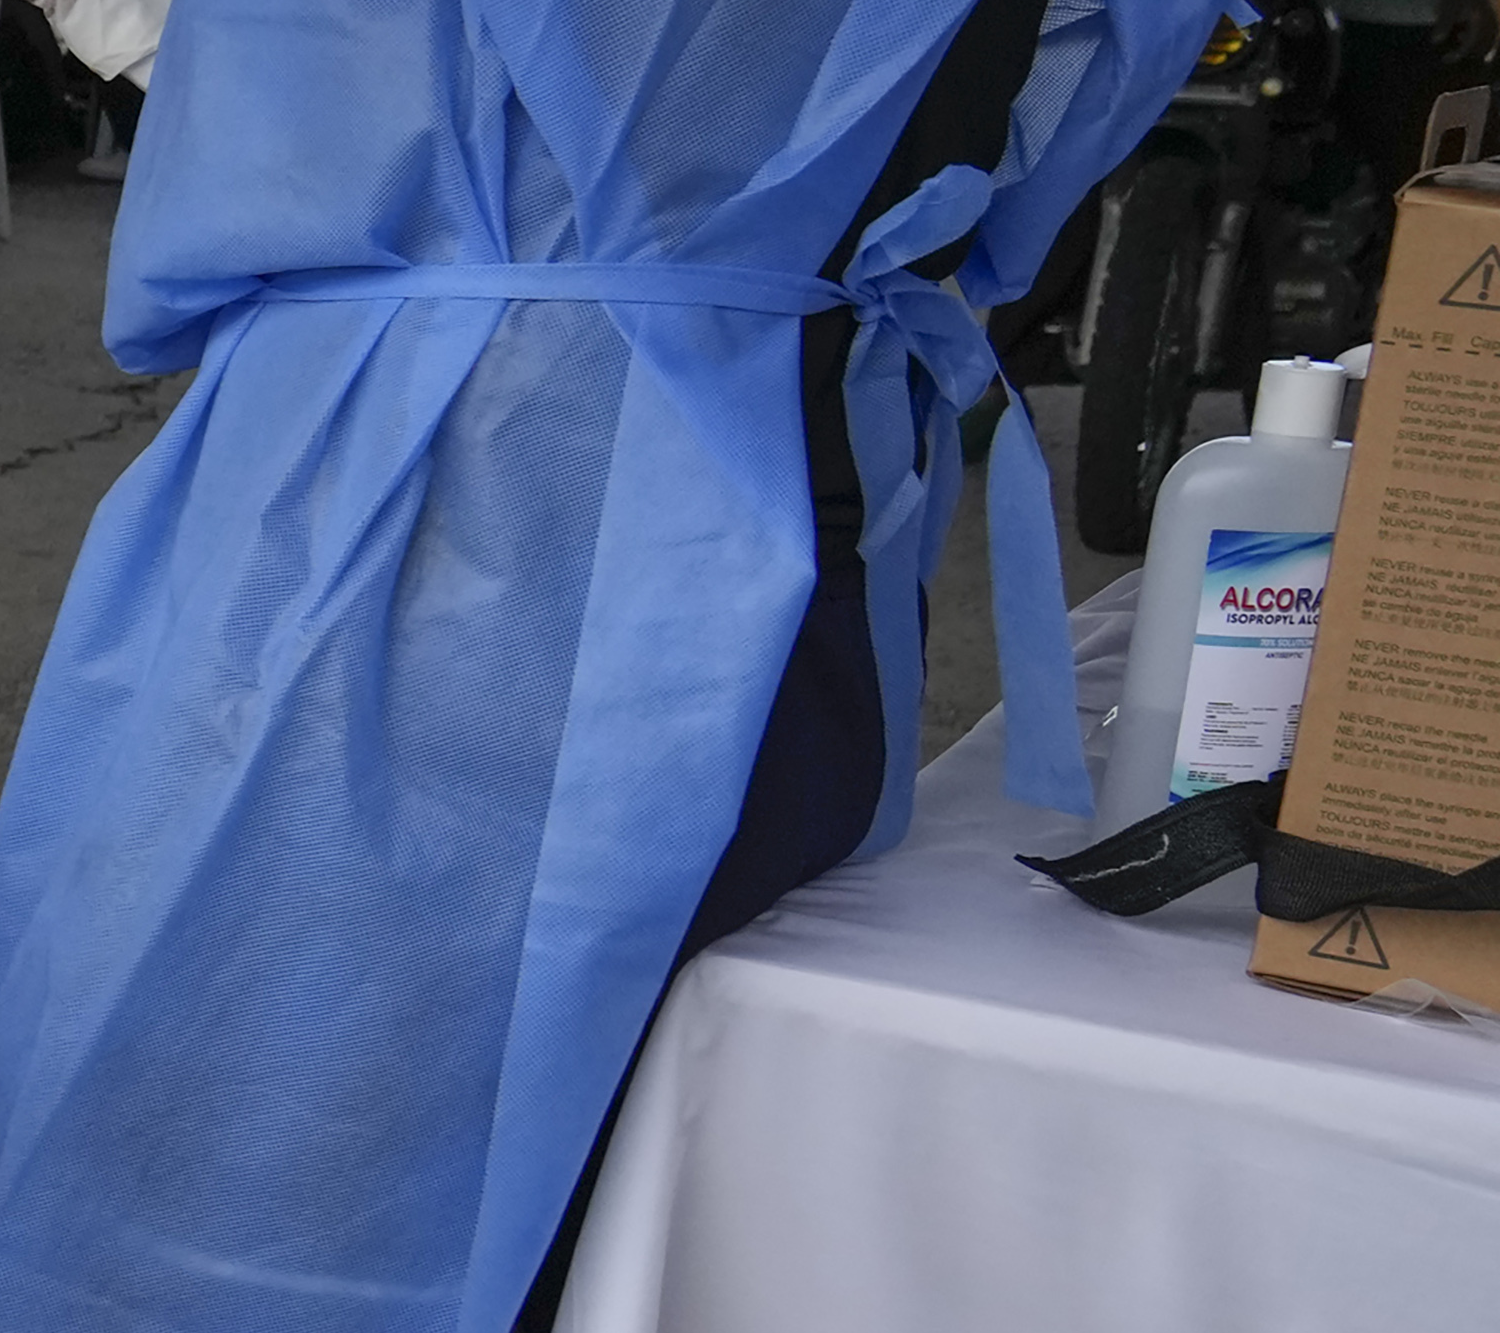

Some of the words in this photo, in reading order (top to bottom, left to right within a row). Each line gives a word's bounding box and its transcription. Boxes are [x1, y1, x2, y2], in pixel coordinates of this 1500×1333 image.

[1407, 370, 1462, 385] ALWAYS
[1403, 399, 1476, 417] TOUJOURS
[1397, 429, 1457, 446] SIEMPRE
[1385, 486, 1431, 502] NEVER
[1382, 501, 1401, 513] NE
[1403, 505, 1454, 520] JAMAIS
[1379, 515, 1427, 531] NUNCA
[1371, 557, 1417, 573] NEVER
[1367, 571, 1386, 583] NE
[1389, 574, 1438, 590] JAMAIS
[1365, 584, 1413, 600] NUNCA
[1226, 613, 1296, 625] ISOPROPYL
[1354, 638, 1400, 654] NEVER
[1403, 647, 1448, 662] remove
[1450, 653, 1471, 665] the
[1350, 652, 1369, 664] NE
[1372, 657, 1422, 673] JAMAIS
[1348, 666, 1395, 682] NUNCA
[1336, 724, 1355, 737] NE
[1358, 729, 1406, 745] JAMAIS
[1338, 710, 1385, 727] NEVER
[1387, 719, 1421, 734] recap
[1424, 725, 1444, 737] the
[1447, 729, 1488, 744] needle
[1333, 738, 1380, 754] NUNCA
[1324, 781, 1377, 798] ALWAYS
[1379, 791, 1413, 805] place
[1415, 797, 1434, 809] the
[1438, 801, 1482, 817] syringe
[1320, 809, 1391, 831] TOUJOURS
